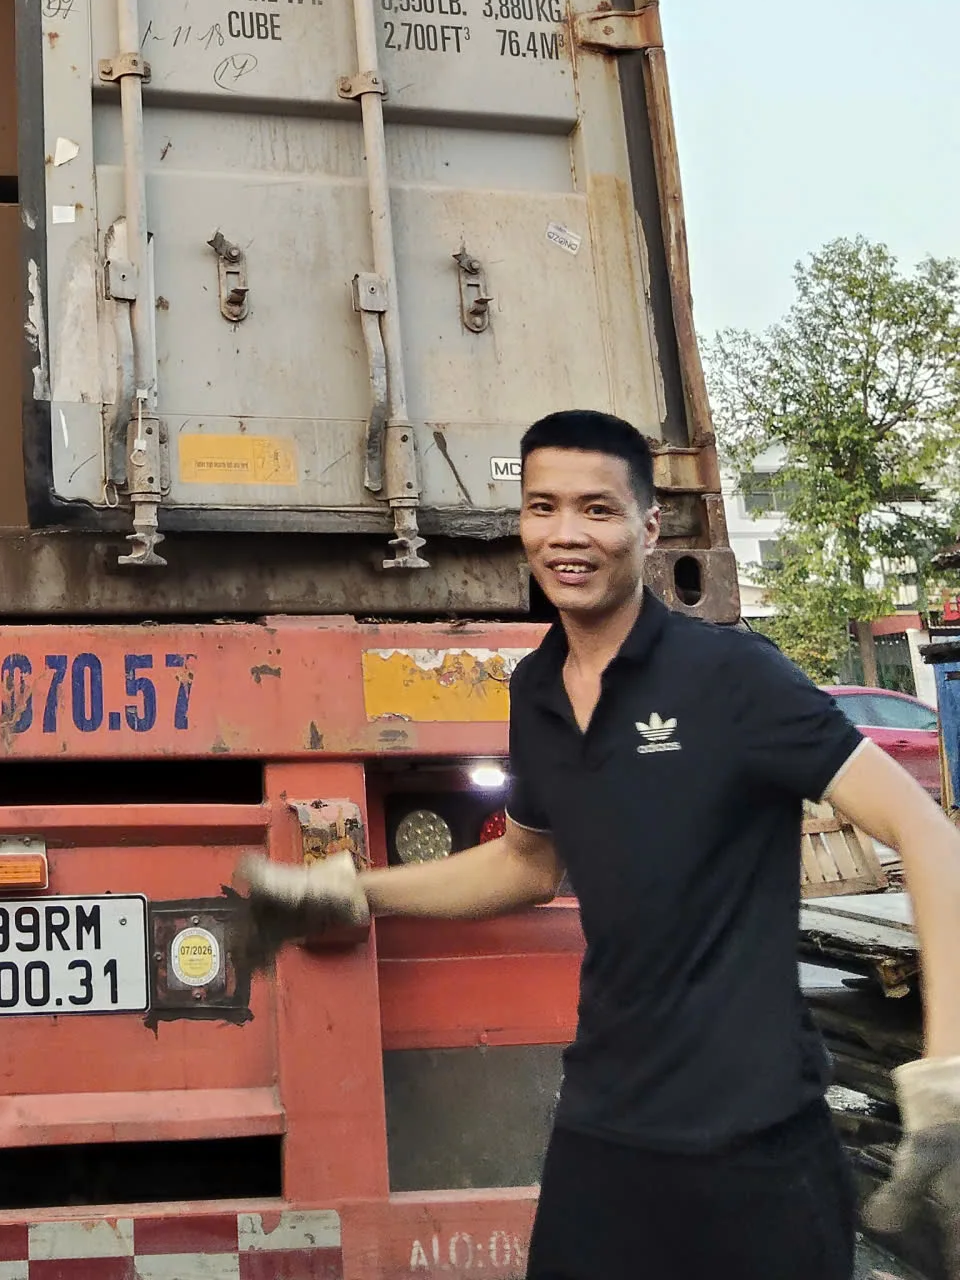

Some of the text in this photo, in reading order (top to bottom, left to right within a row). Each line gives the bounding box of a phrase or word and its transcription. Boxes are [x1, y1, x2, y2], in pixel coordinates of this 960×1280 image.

[227, 10, 282, 41] CUBE
[0, 652, 198, 735] 070.57
[180, 946, 212, 955] 07/2026
